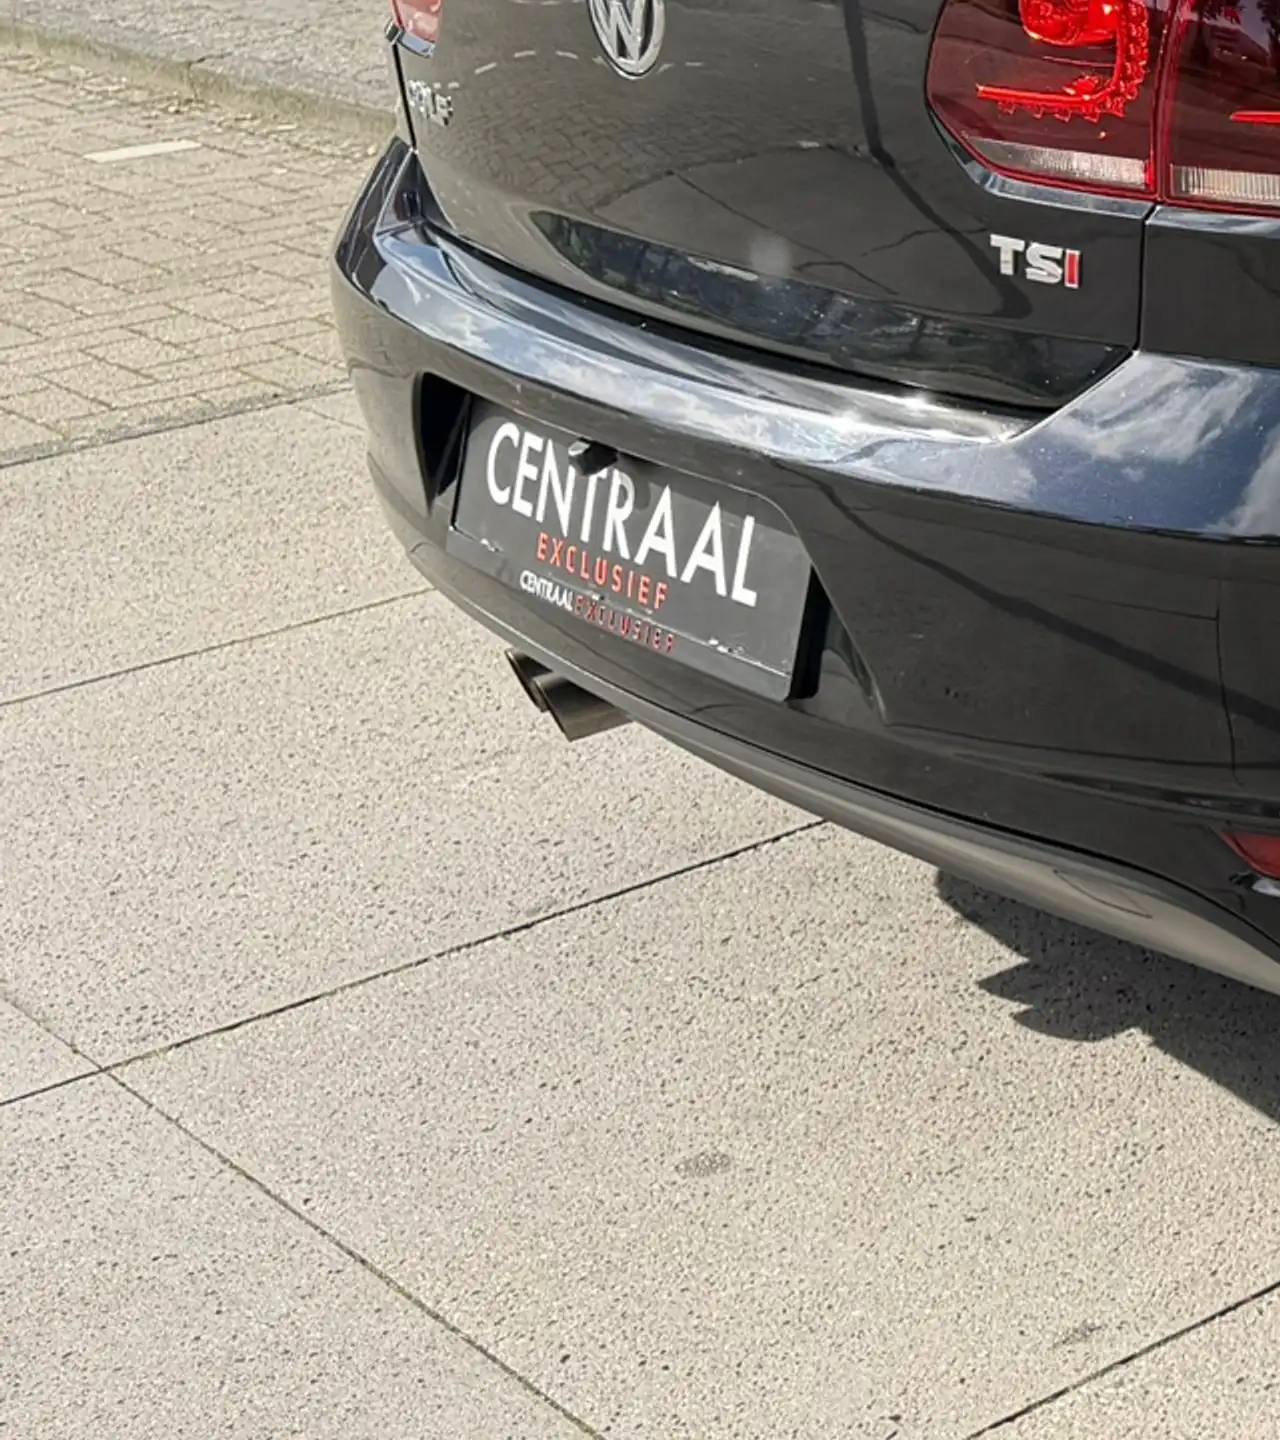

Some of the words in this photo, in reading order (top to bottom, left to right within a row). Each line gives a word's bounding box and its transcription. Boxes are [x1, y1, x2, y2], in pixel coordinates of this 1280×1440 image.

[989, 233, 1082, 290] TSI
[487, 421, 757, 608] CENTRAAL
[536, 531, 669, 610] EXCLUSIEF
